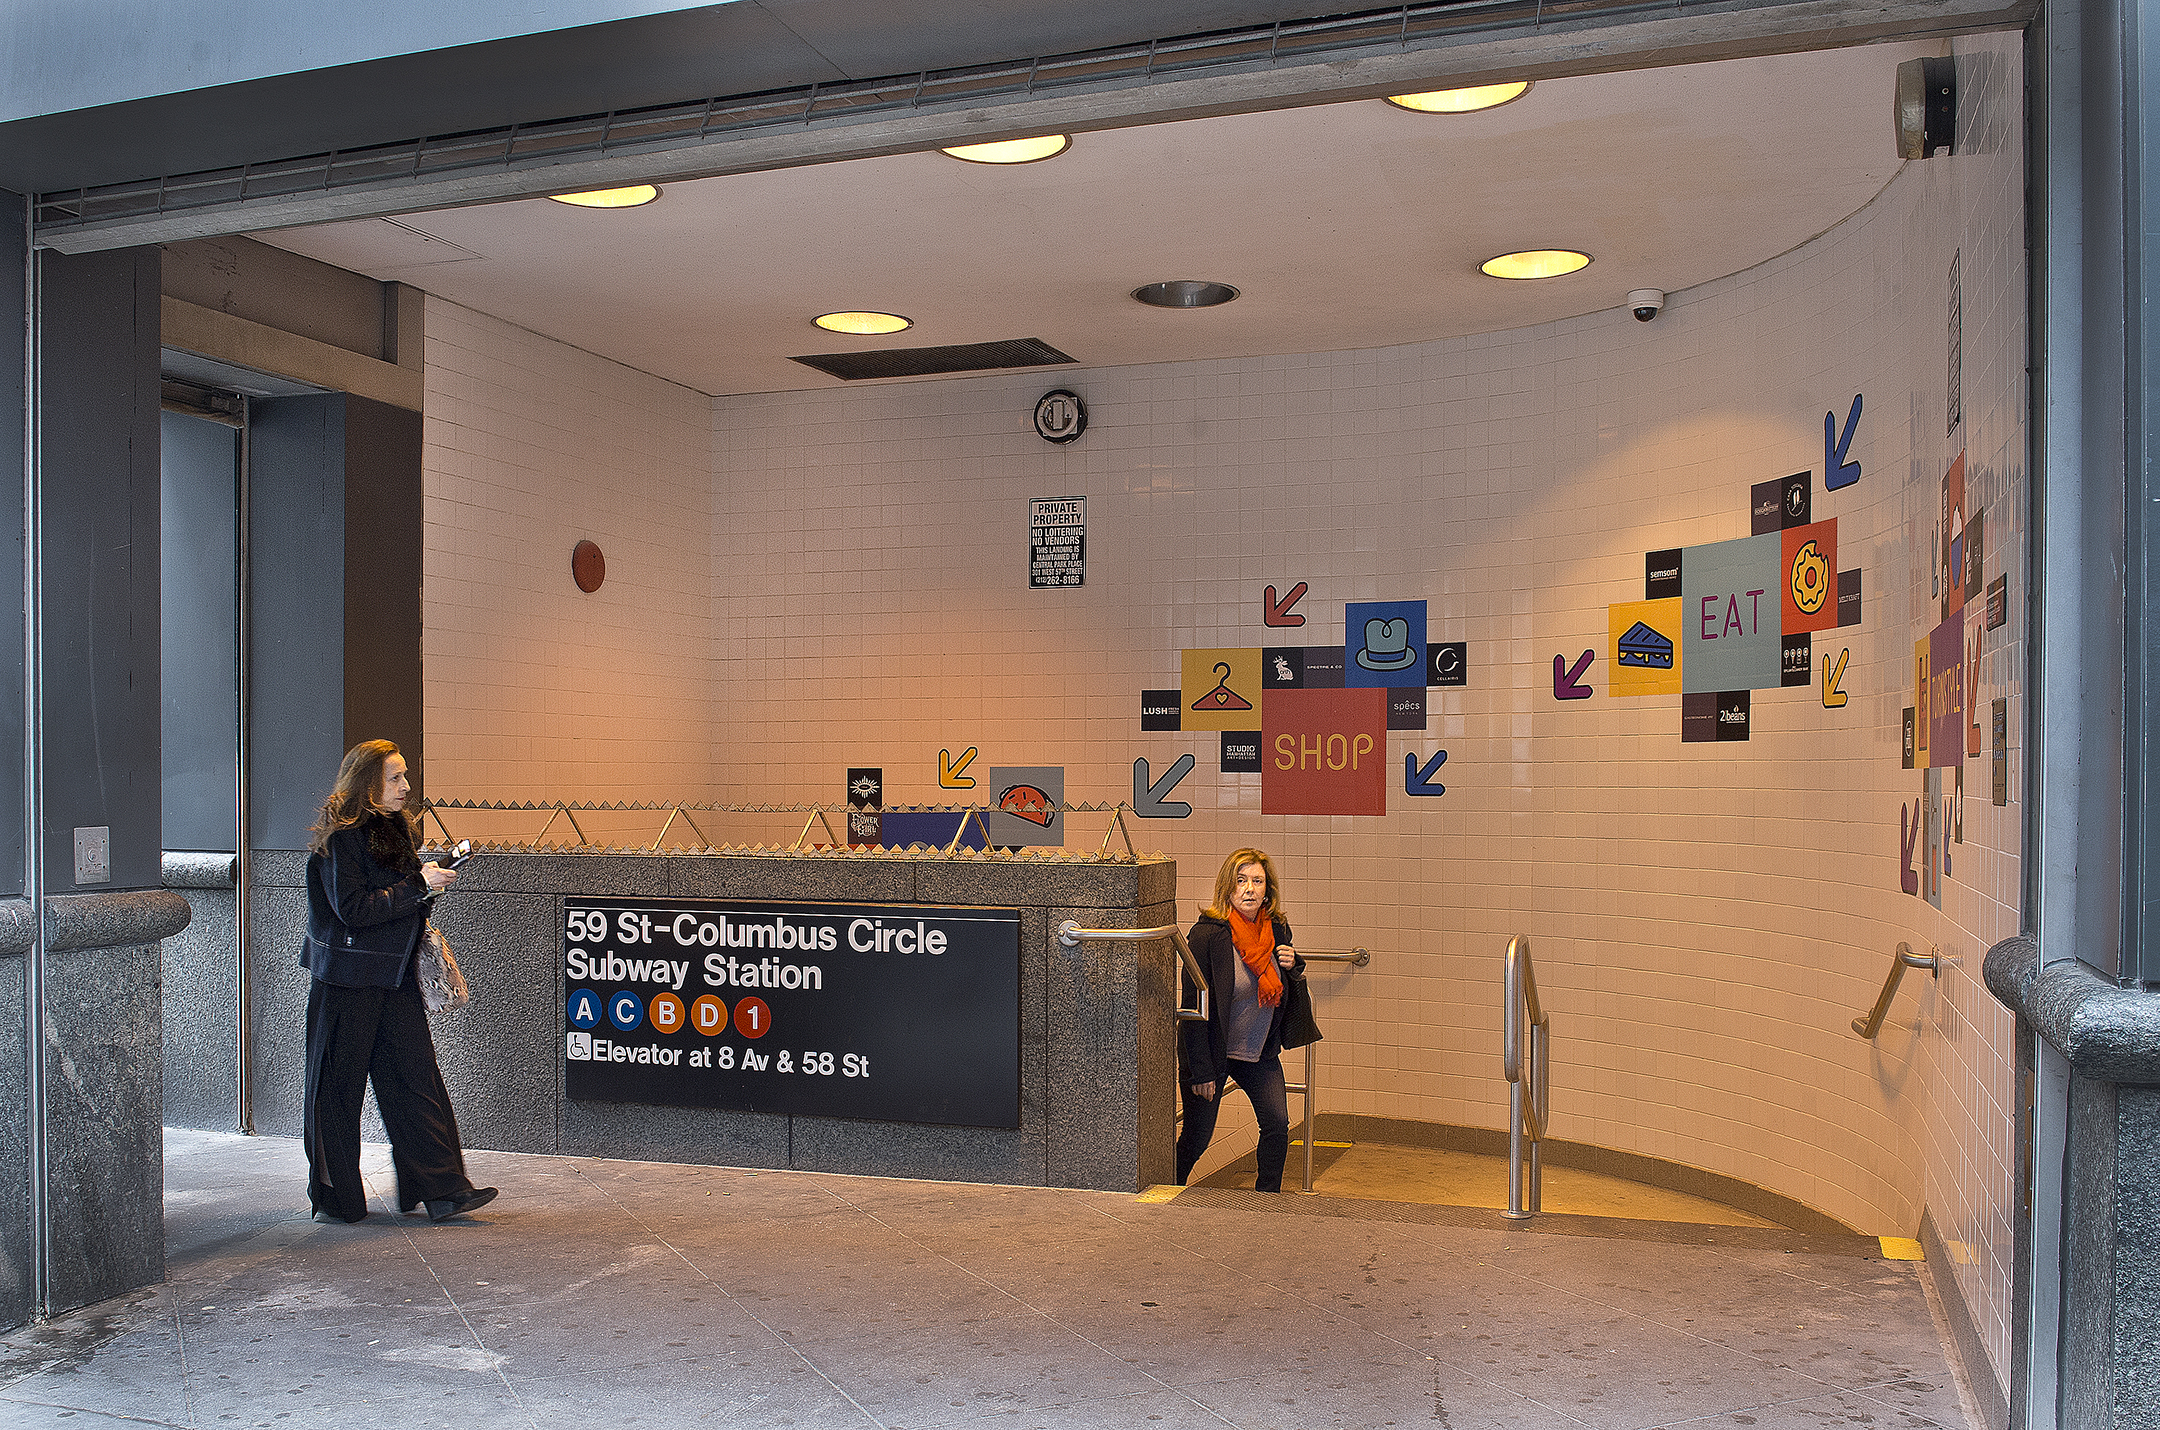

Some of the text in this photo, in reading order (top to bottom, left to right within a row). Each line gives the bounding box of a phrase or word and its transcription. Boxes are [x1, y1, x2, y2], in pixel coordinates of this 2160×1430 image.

[1034, 514, 1081, 525] PROPERTY
[1038, 502, 1077, 513] PRIVATE
[1032, 527, 1083, 537] NO LOITERING
[1032, 536, 1080, 546] NO VENDORS
[1650, 569, 1677, 578] semsom
[1702, 589, 1764, 640] EAT
[1274, 733, 1374, 770] SHOP
[566, 911, 948, 955] 59 St-Columbus Circle
[566, 948, 822, 990] Subway Station
[575, 997, 758, 1030] A C B D 1
[592, 1039, 869, 1078] Elevator at 8 Av & 58 St
